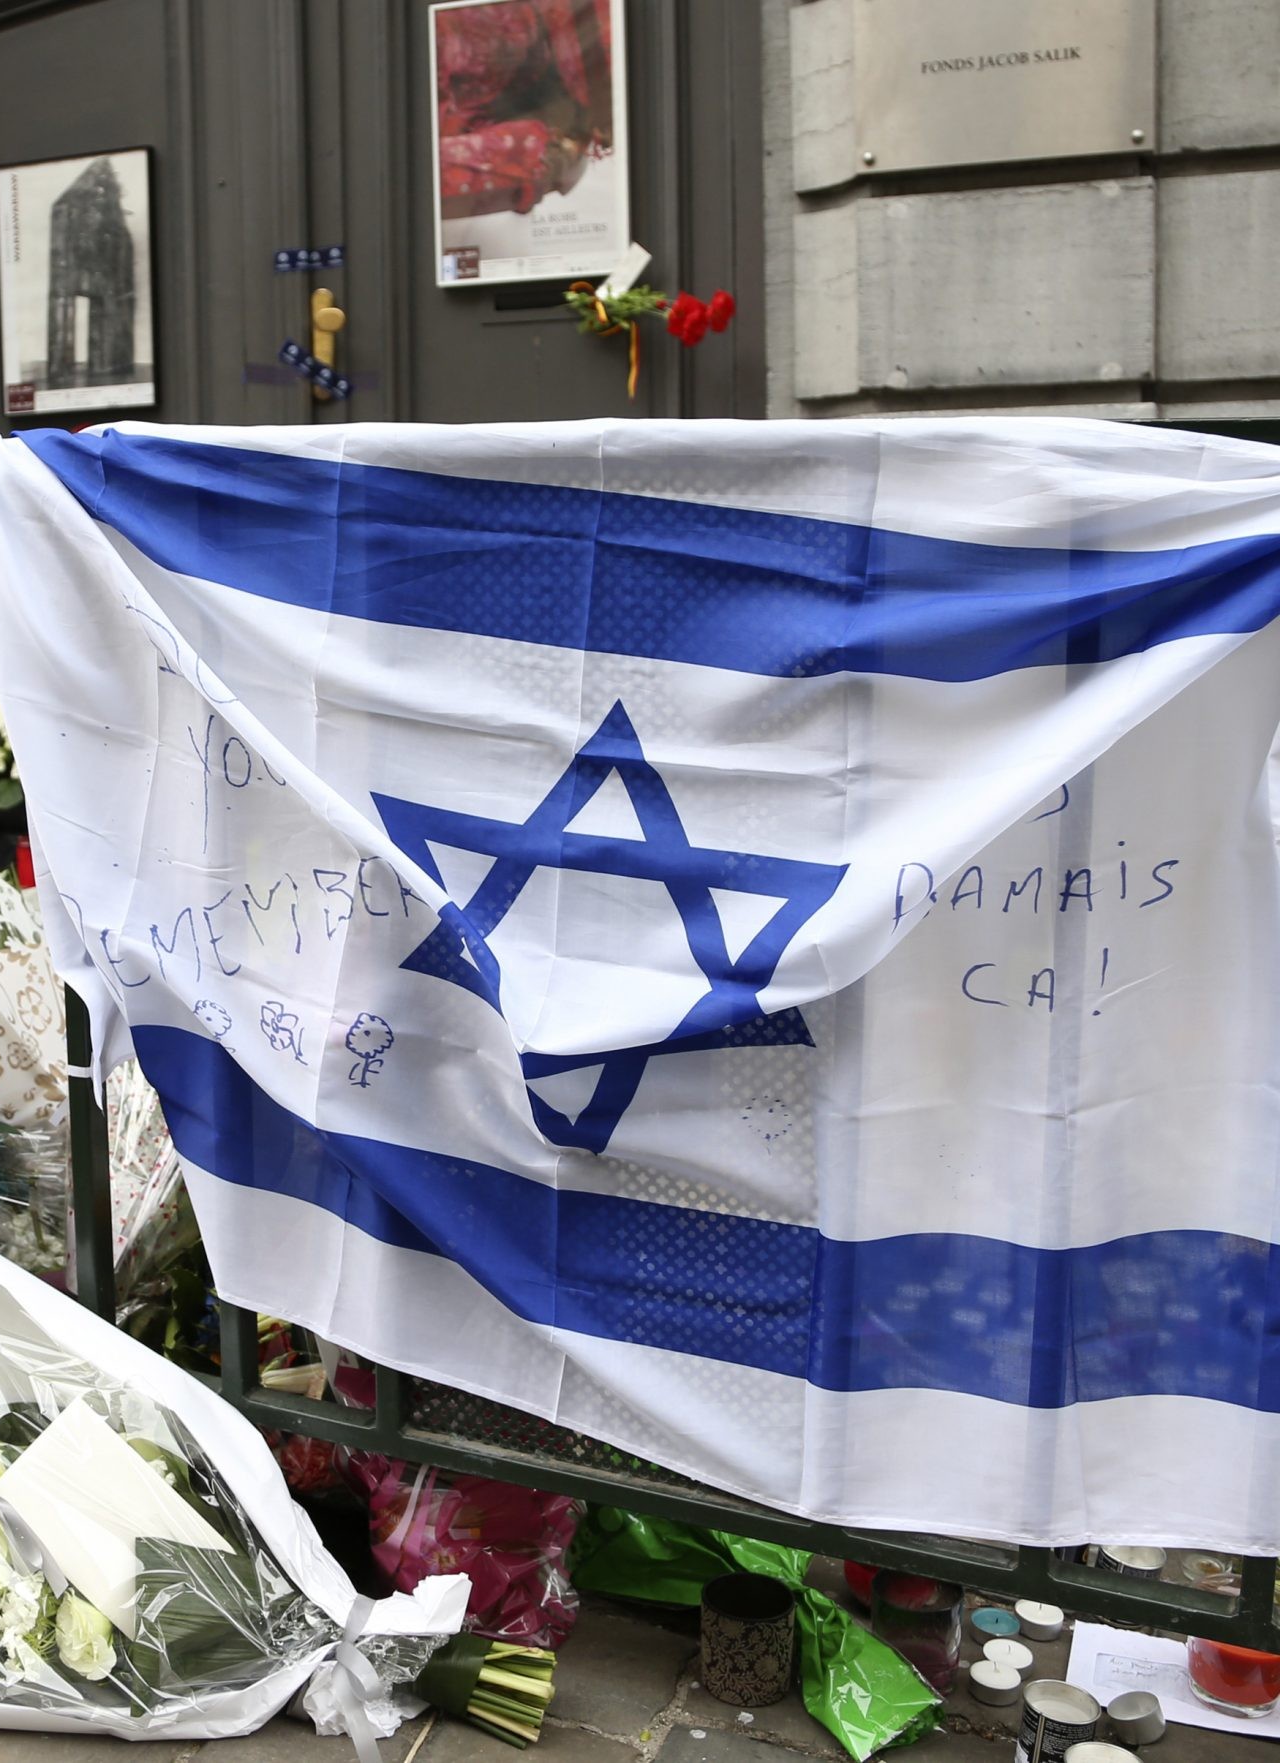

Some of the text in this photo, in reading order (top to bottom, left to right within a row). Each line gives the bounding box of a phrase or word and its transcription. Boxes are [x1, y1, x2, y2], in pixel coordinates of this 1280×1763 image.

[921, 47, 1081, 75] FONDS JACOB SALIK
